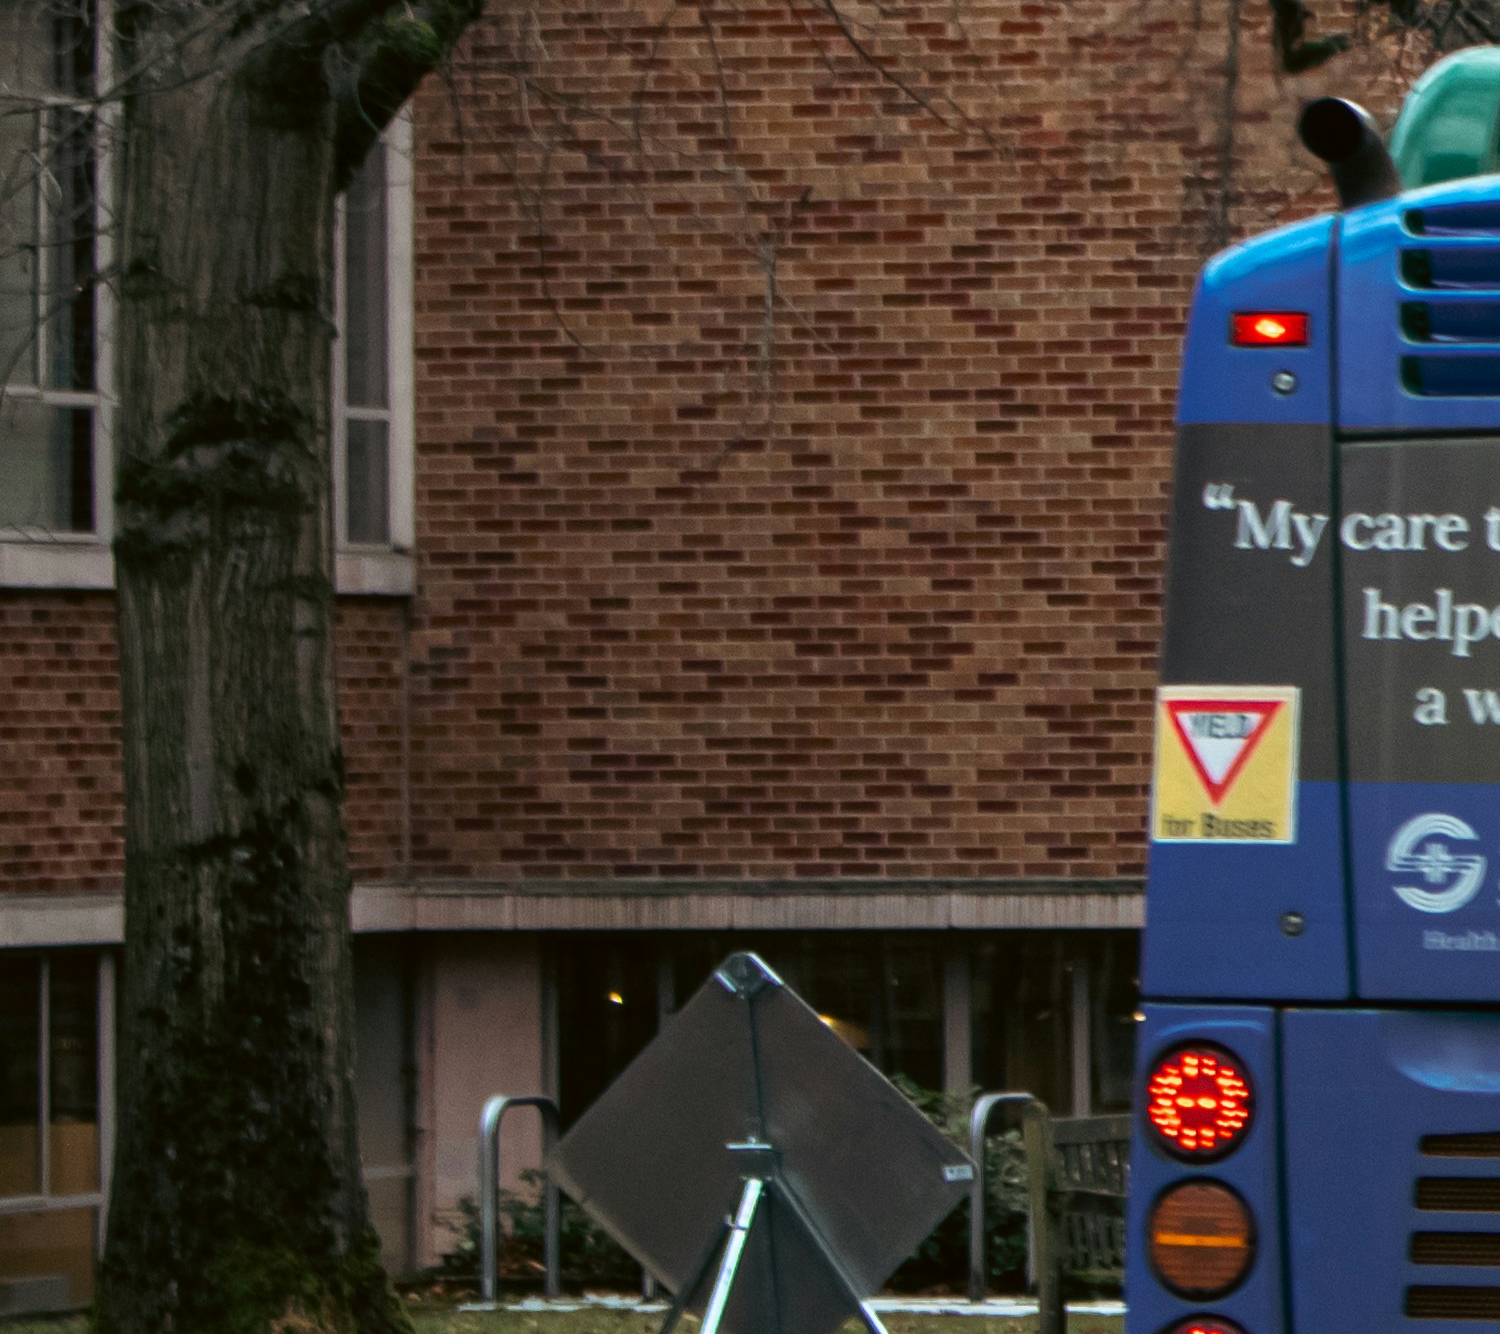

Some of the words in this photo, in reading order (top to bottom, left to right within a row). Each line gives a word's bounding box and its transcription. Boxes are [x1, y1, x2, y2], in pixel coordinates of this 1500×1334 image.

[1203, 483, 1329, 564] “My
[1341, 512, 1468, 552] care
[1414, 689, 1446, 726] a
[1201, 813, 1277, 839] Buses
[1423, 930, 1499, 952] Health
